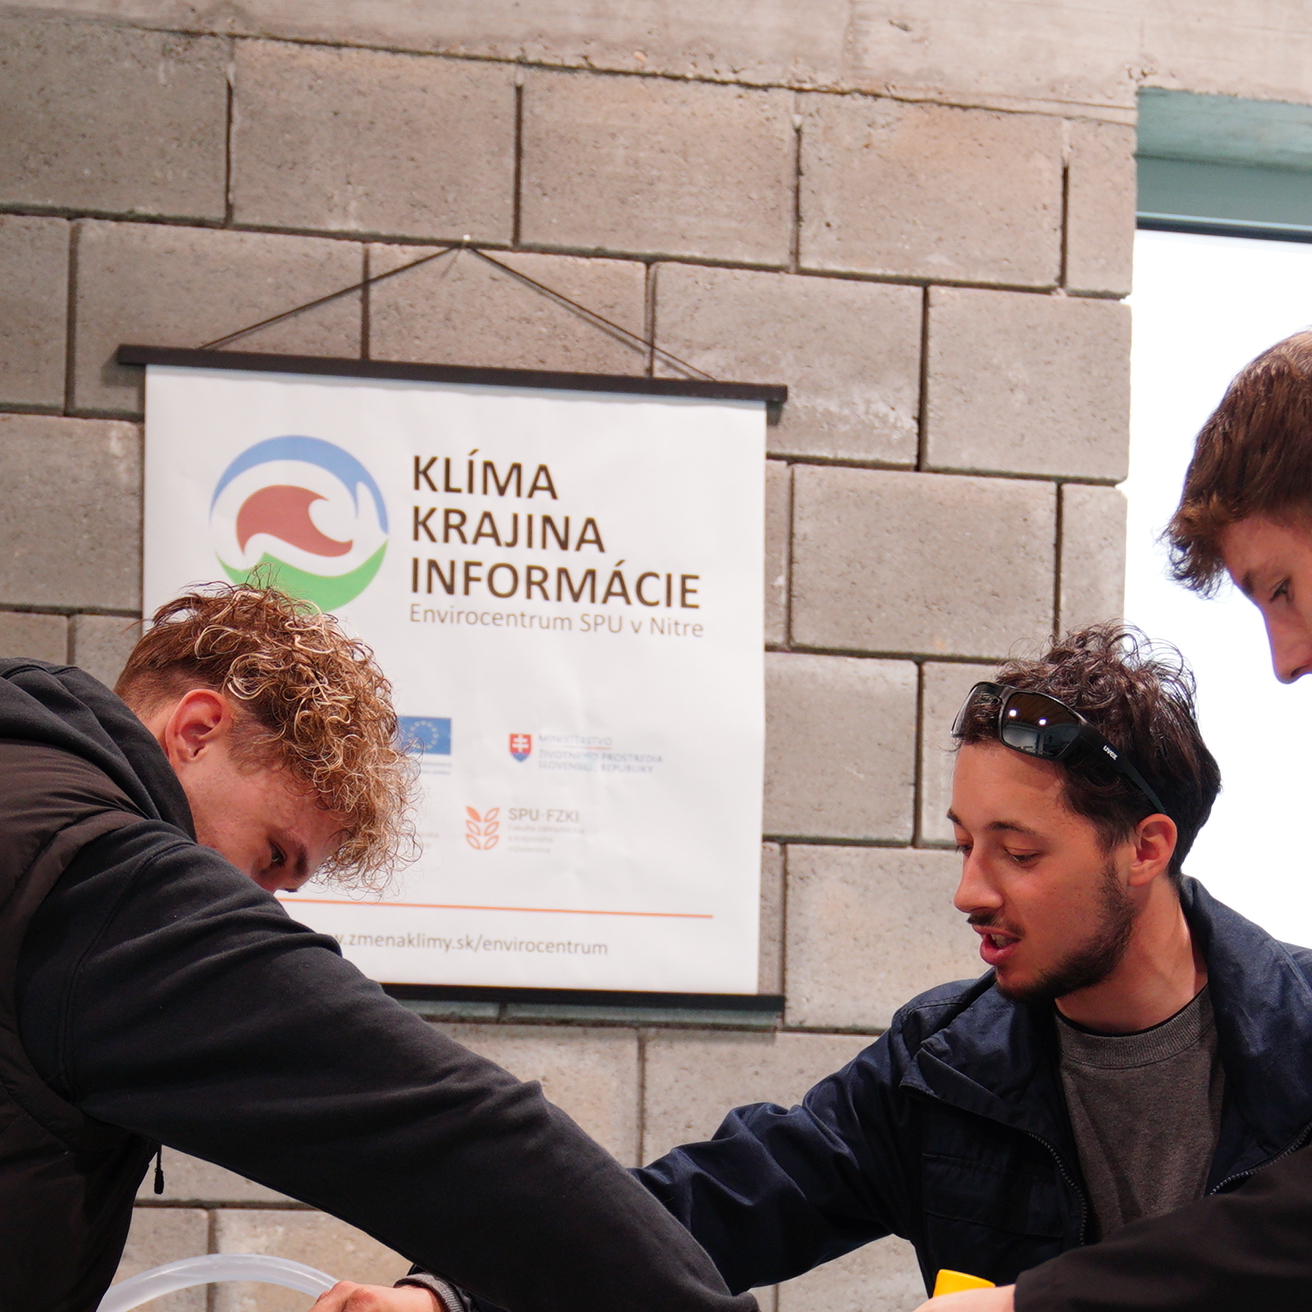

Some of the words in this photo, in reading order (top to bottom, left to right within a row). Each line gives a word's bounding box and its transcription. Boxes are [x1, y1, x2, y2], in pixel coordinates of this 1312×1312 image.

[412, 448, 558, 500] KLÍMA
[412, 505, 606, 553] KRAJINA
[411, 557, 701, 609] INFORMÁCIE
[409, 603, 573, 632] Envirocentrum
[579, 613, 623, 634] SPU
[629, 619, 643, 634] v
[650, 616, 704, 638] Nitre
